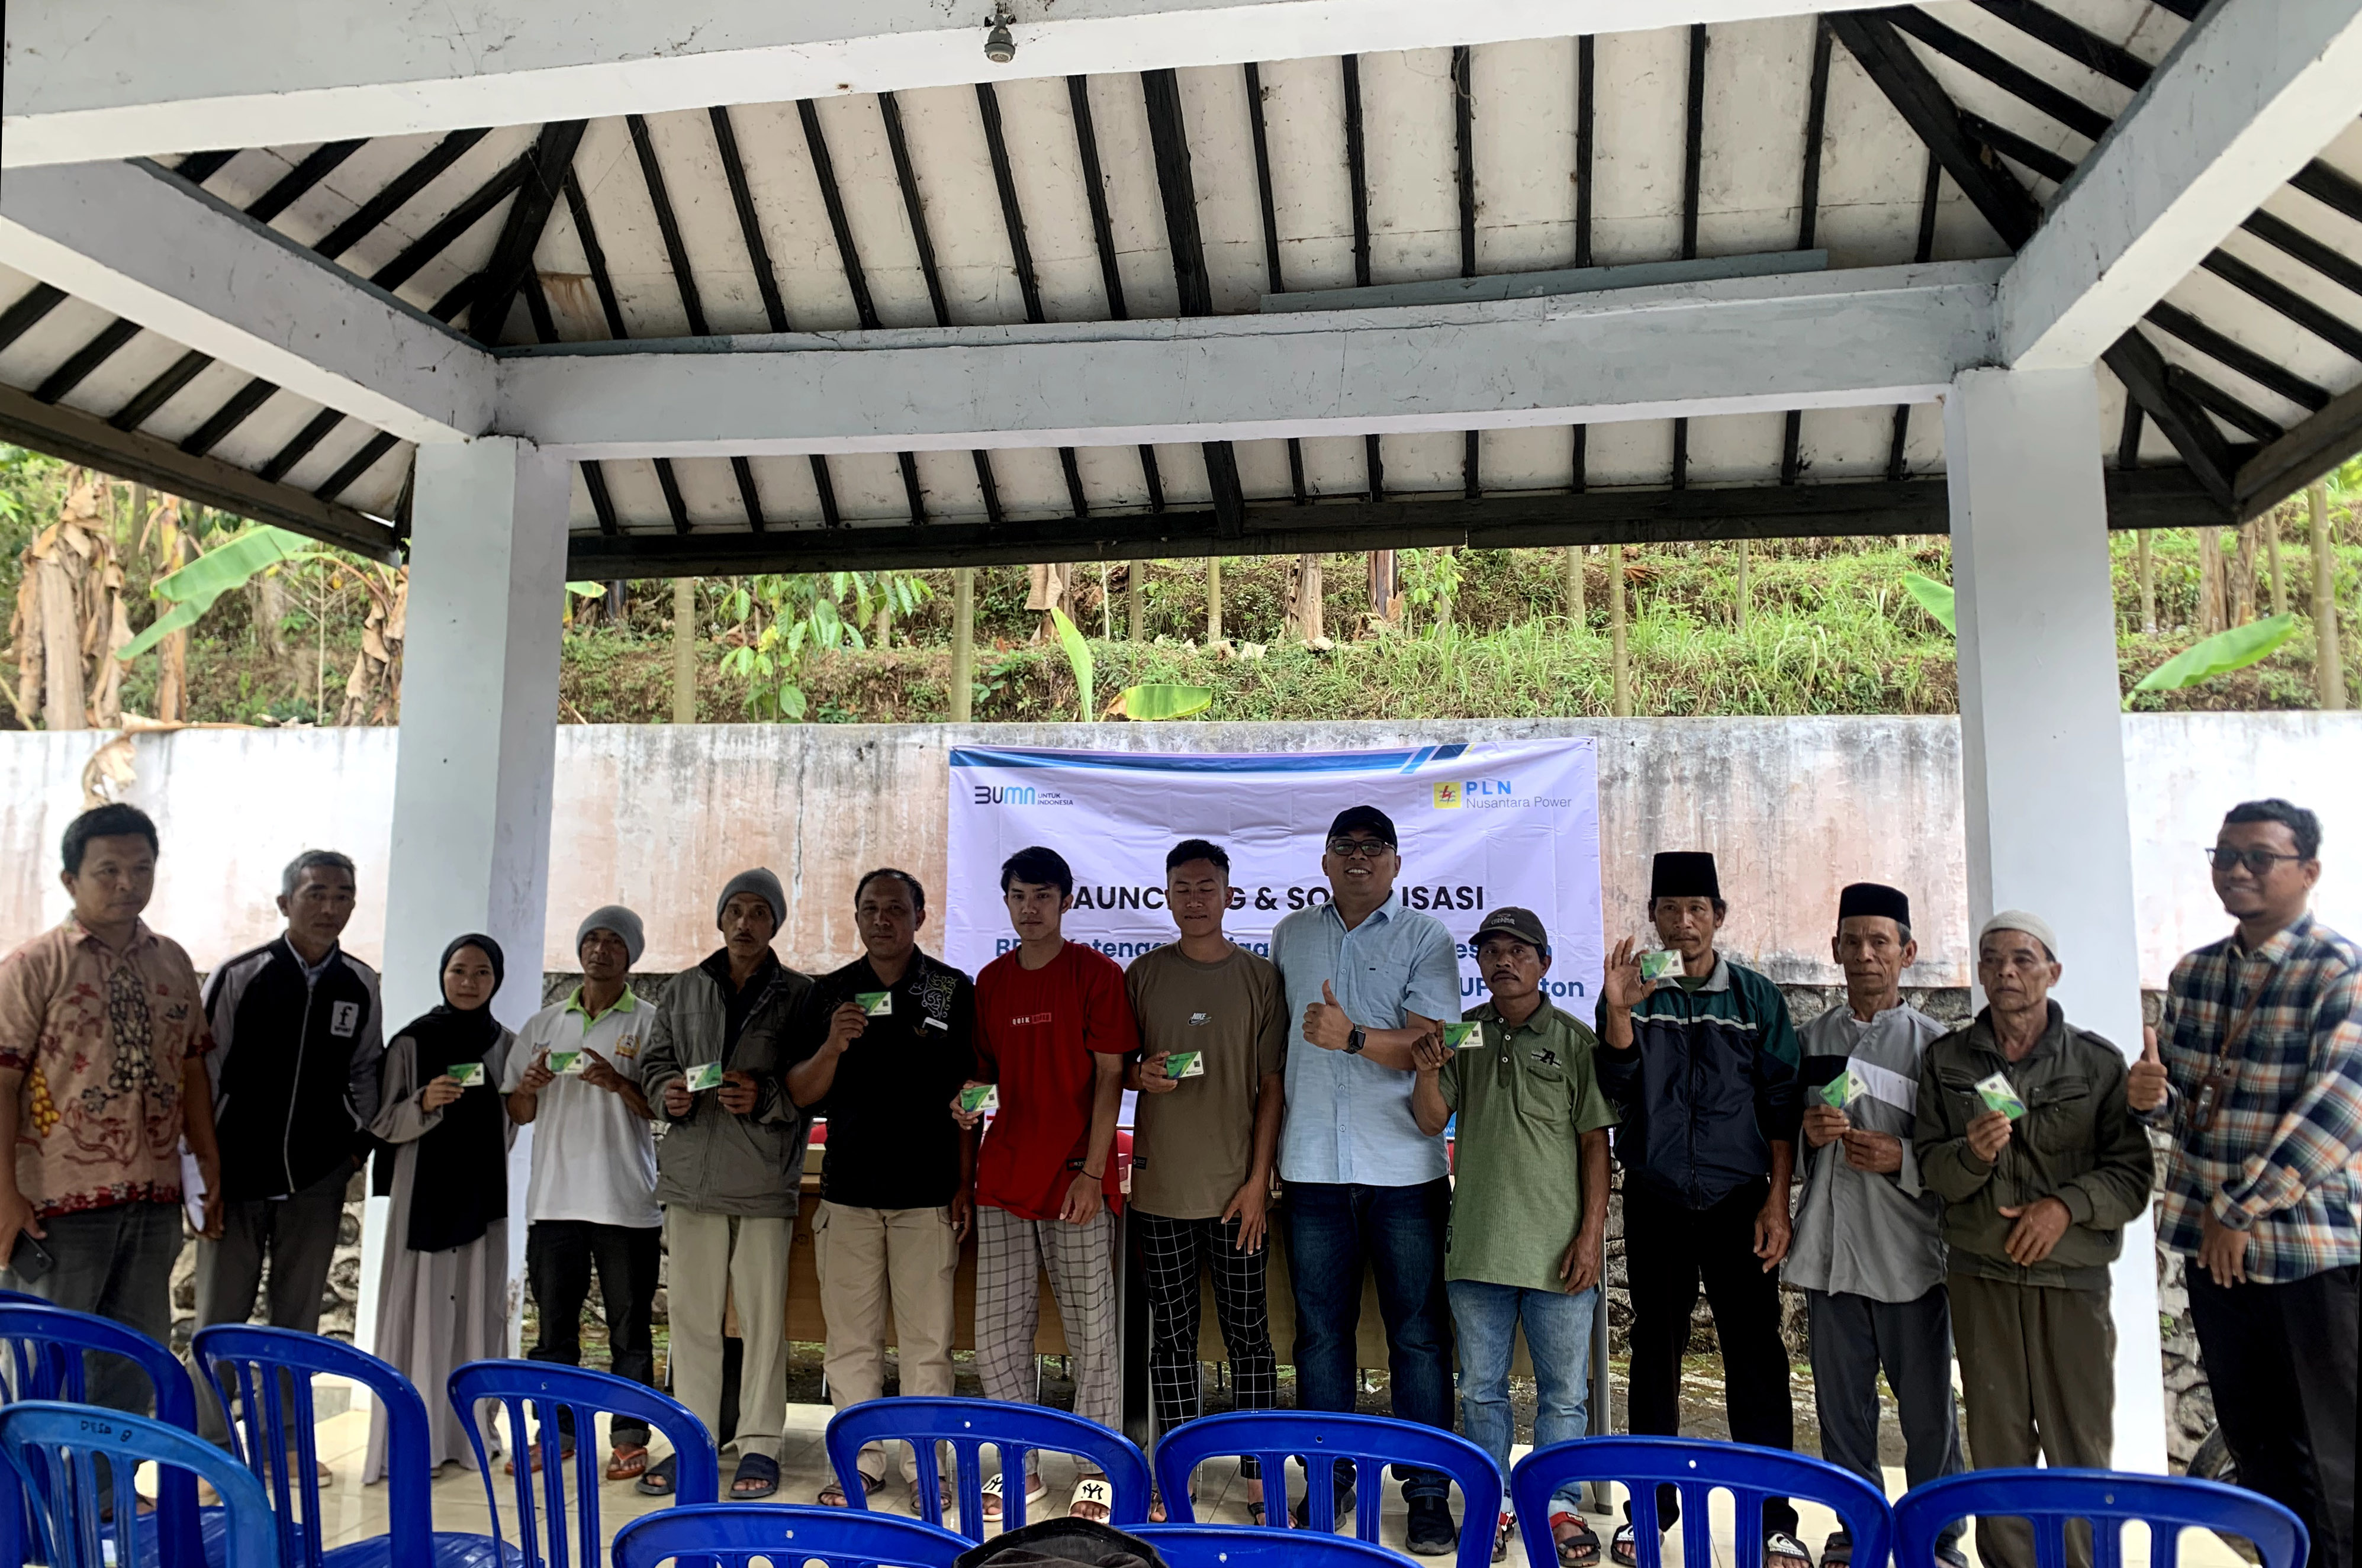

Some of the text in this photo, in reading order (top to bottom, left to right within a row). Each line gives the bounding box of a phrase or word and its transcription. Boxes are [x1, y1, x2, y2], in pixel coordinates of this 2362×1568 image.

[974, 785, 1035, 805] BUMN
[1466, 781, 1511, 795] PLN
[1466, 796, 1572, 809] Nusantara Power
[1068, 886, 1484, 910] AUNCG & SOISASI
